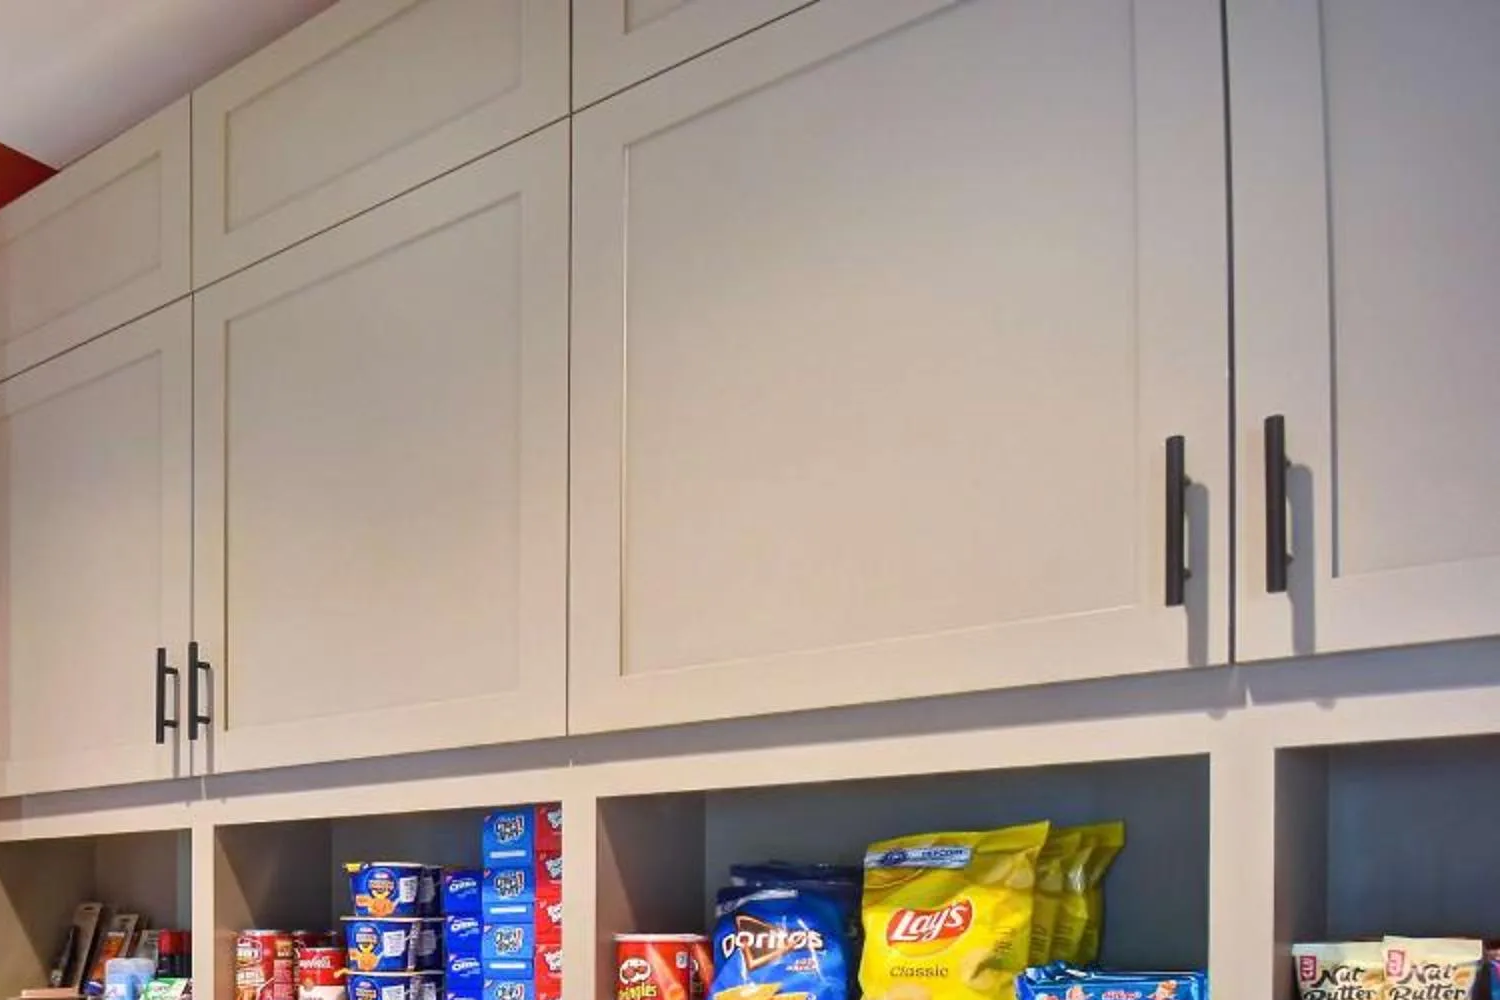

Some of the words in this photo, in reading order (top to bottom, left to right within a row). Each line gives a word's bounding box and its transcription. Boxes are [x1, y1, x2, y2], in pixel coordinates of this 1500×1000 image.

[891, 900, 965, 942] Lay's
[721, 926, 824, 958] Doritos
[889, 965, 949, 980] Classic
[1312, 965, 1366, 988] Nut
